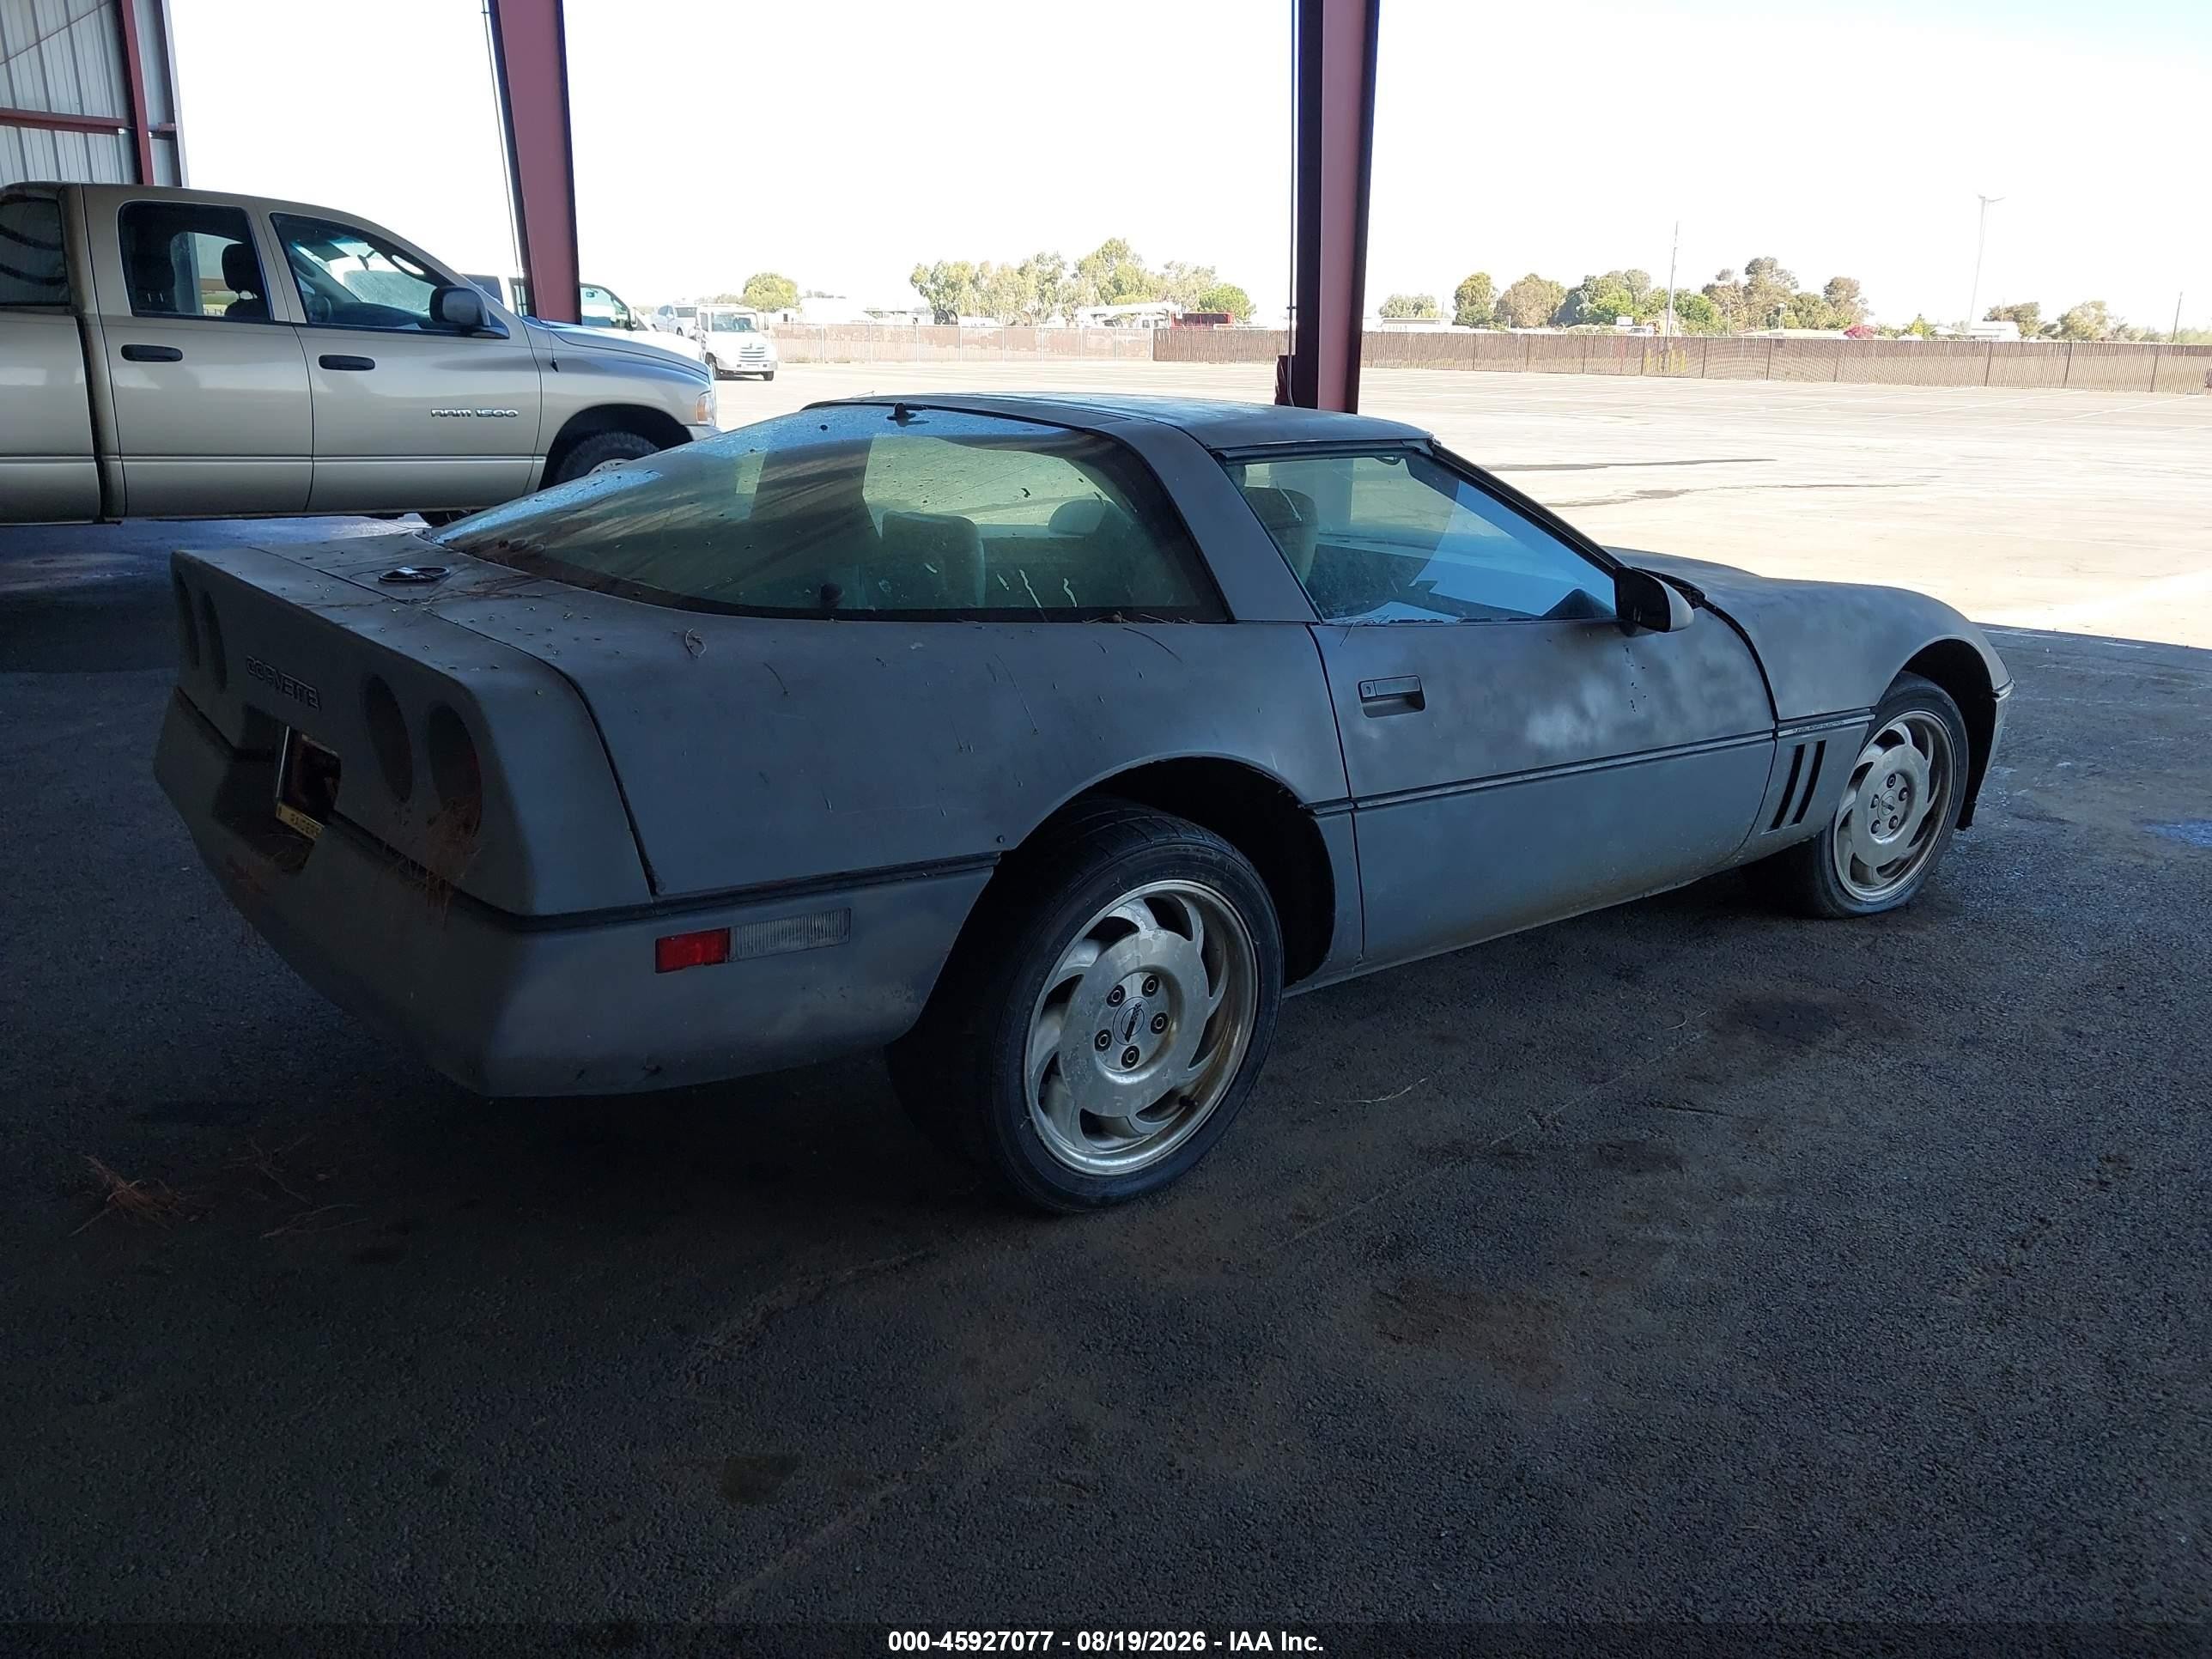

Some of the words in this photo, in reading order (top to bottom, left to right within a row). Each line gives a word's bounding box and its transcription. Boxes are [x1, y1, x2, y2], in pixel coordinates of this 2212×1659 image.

[431, 409, 471, 418] RAM
[475, 409, 519, 418] 1500
[246, 654, 322, 712] CORVETTE
